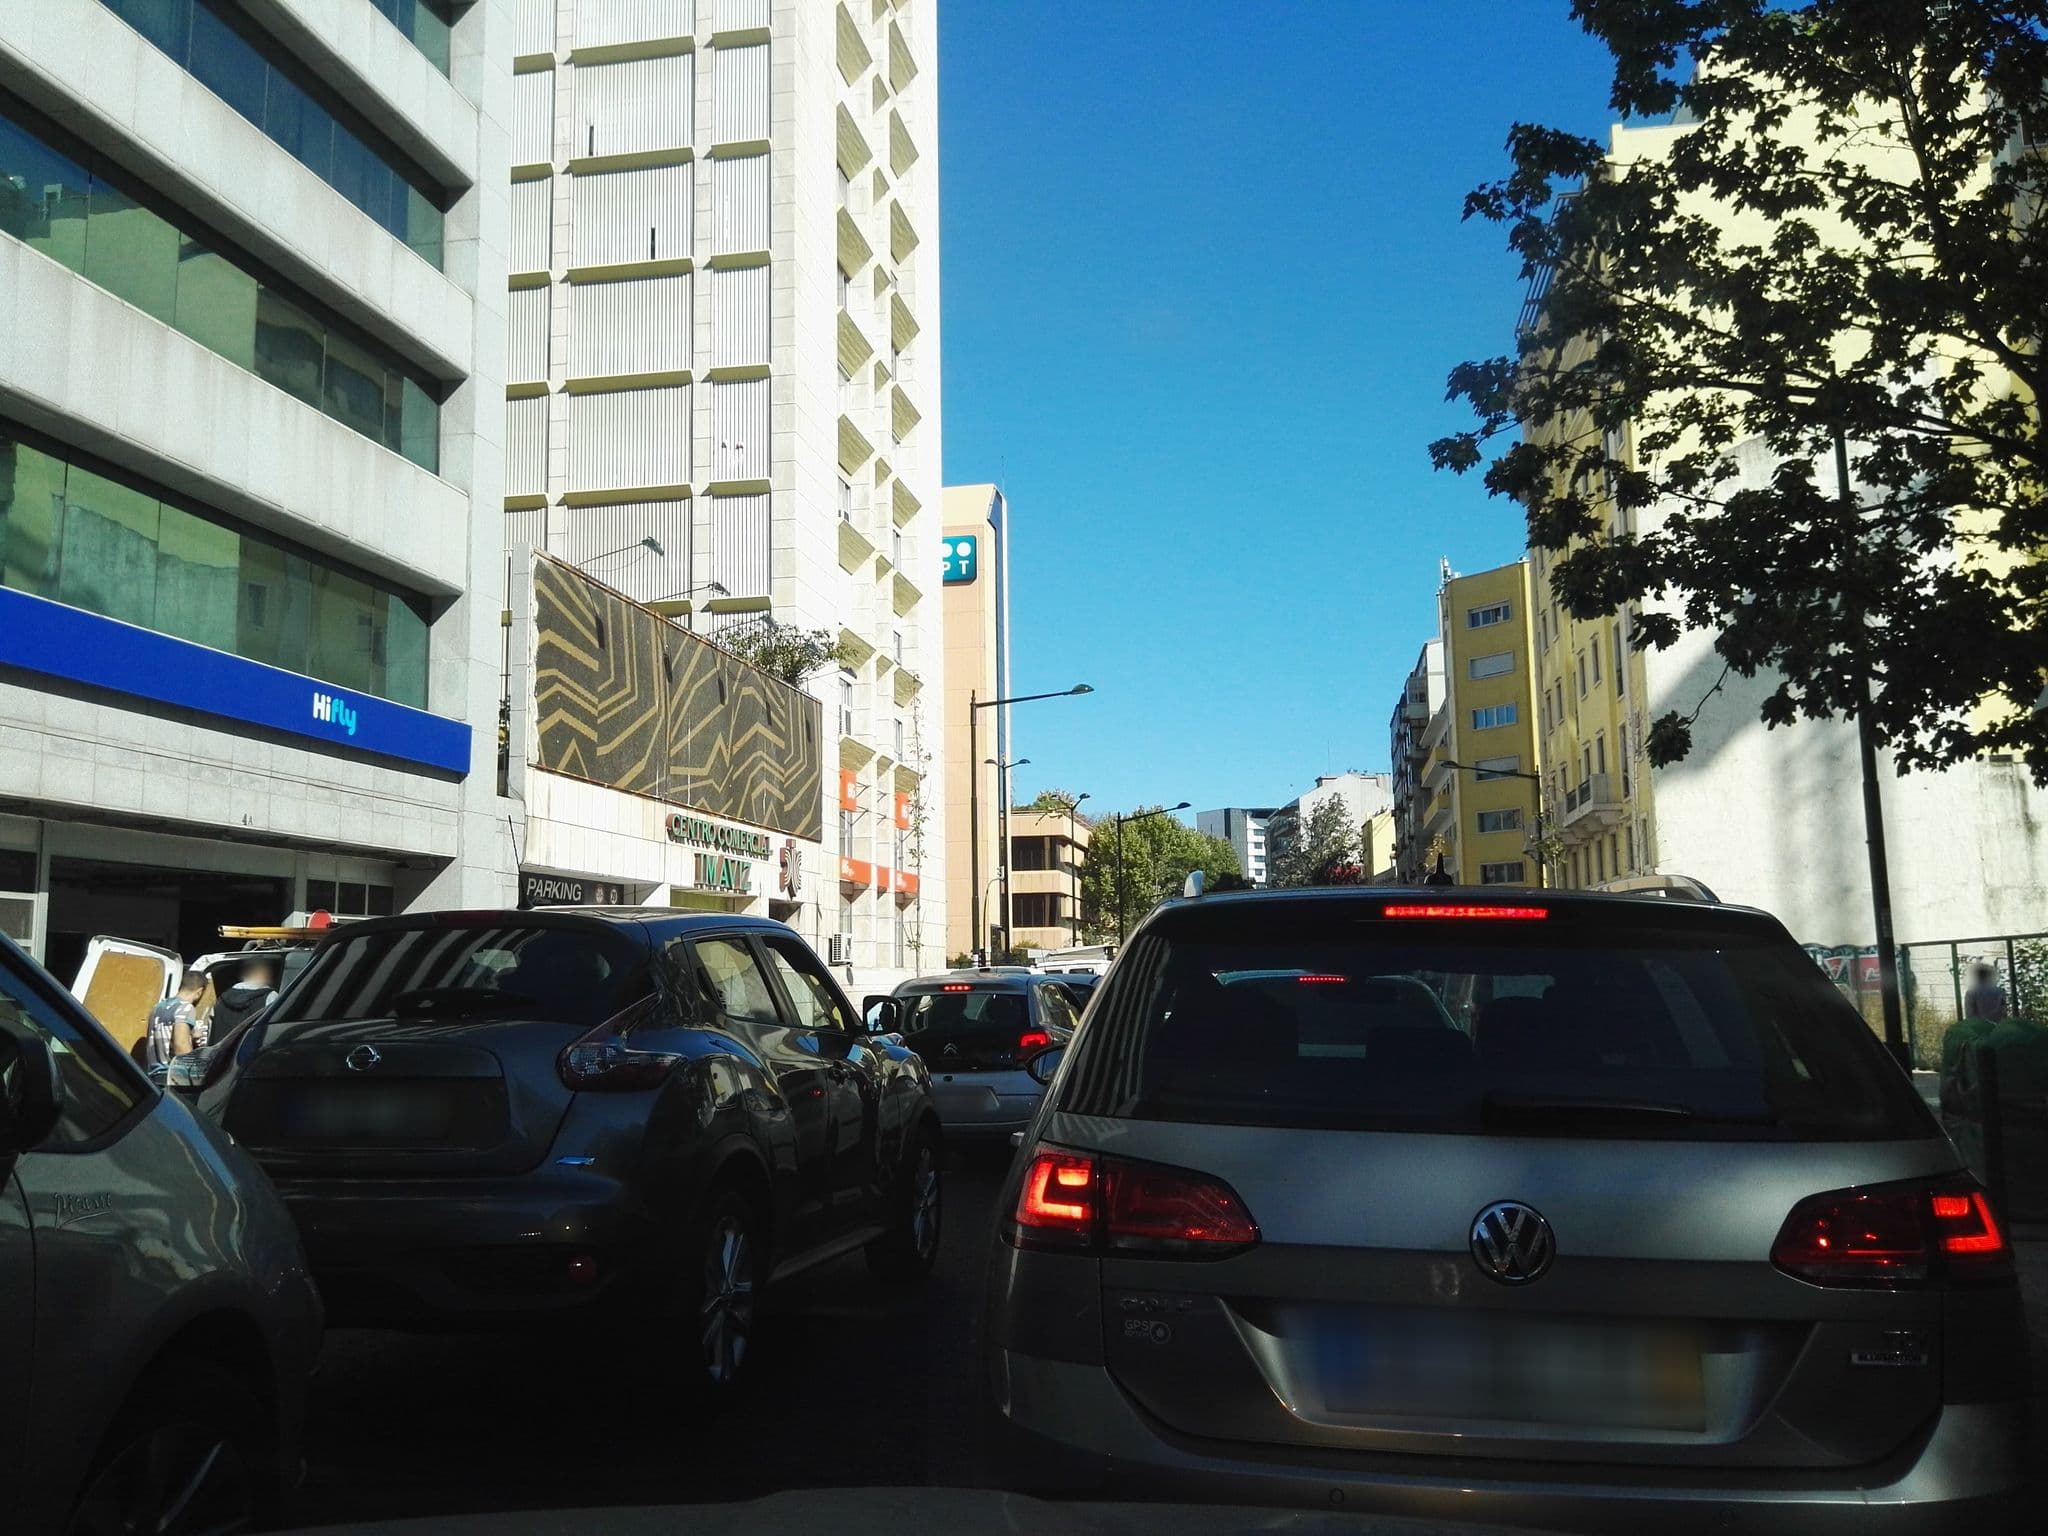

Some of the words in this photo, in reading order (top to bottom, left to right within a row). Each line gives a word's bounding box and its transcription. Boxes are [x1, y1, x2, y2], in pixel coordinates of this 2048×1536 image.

[313, 692, 357, 736] Hifly
[667, 813, 718, 845] CENTRO
[526, 878, 582, 901] PARKING
[697, 853, 752, 891] IMAVIZ
